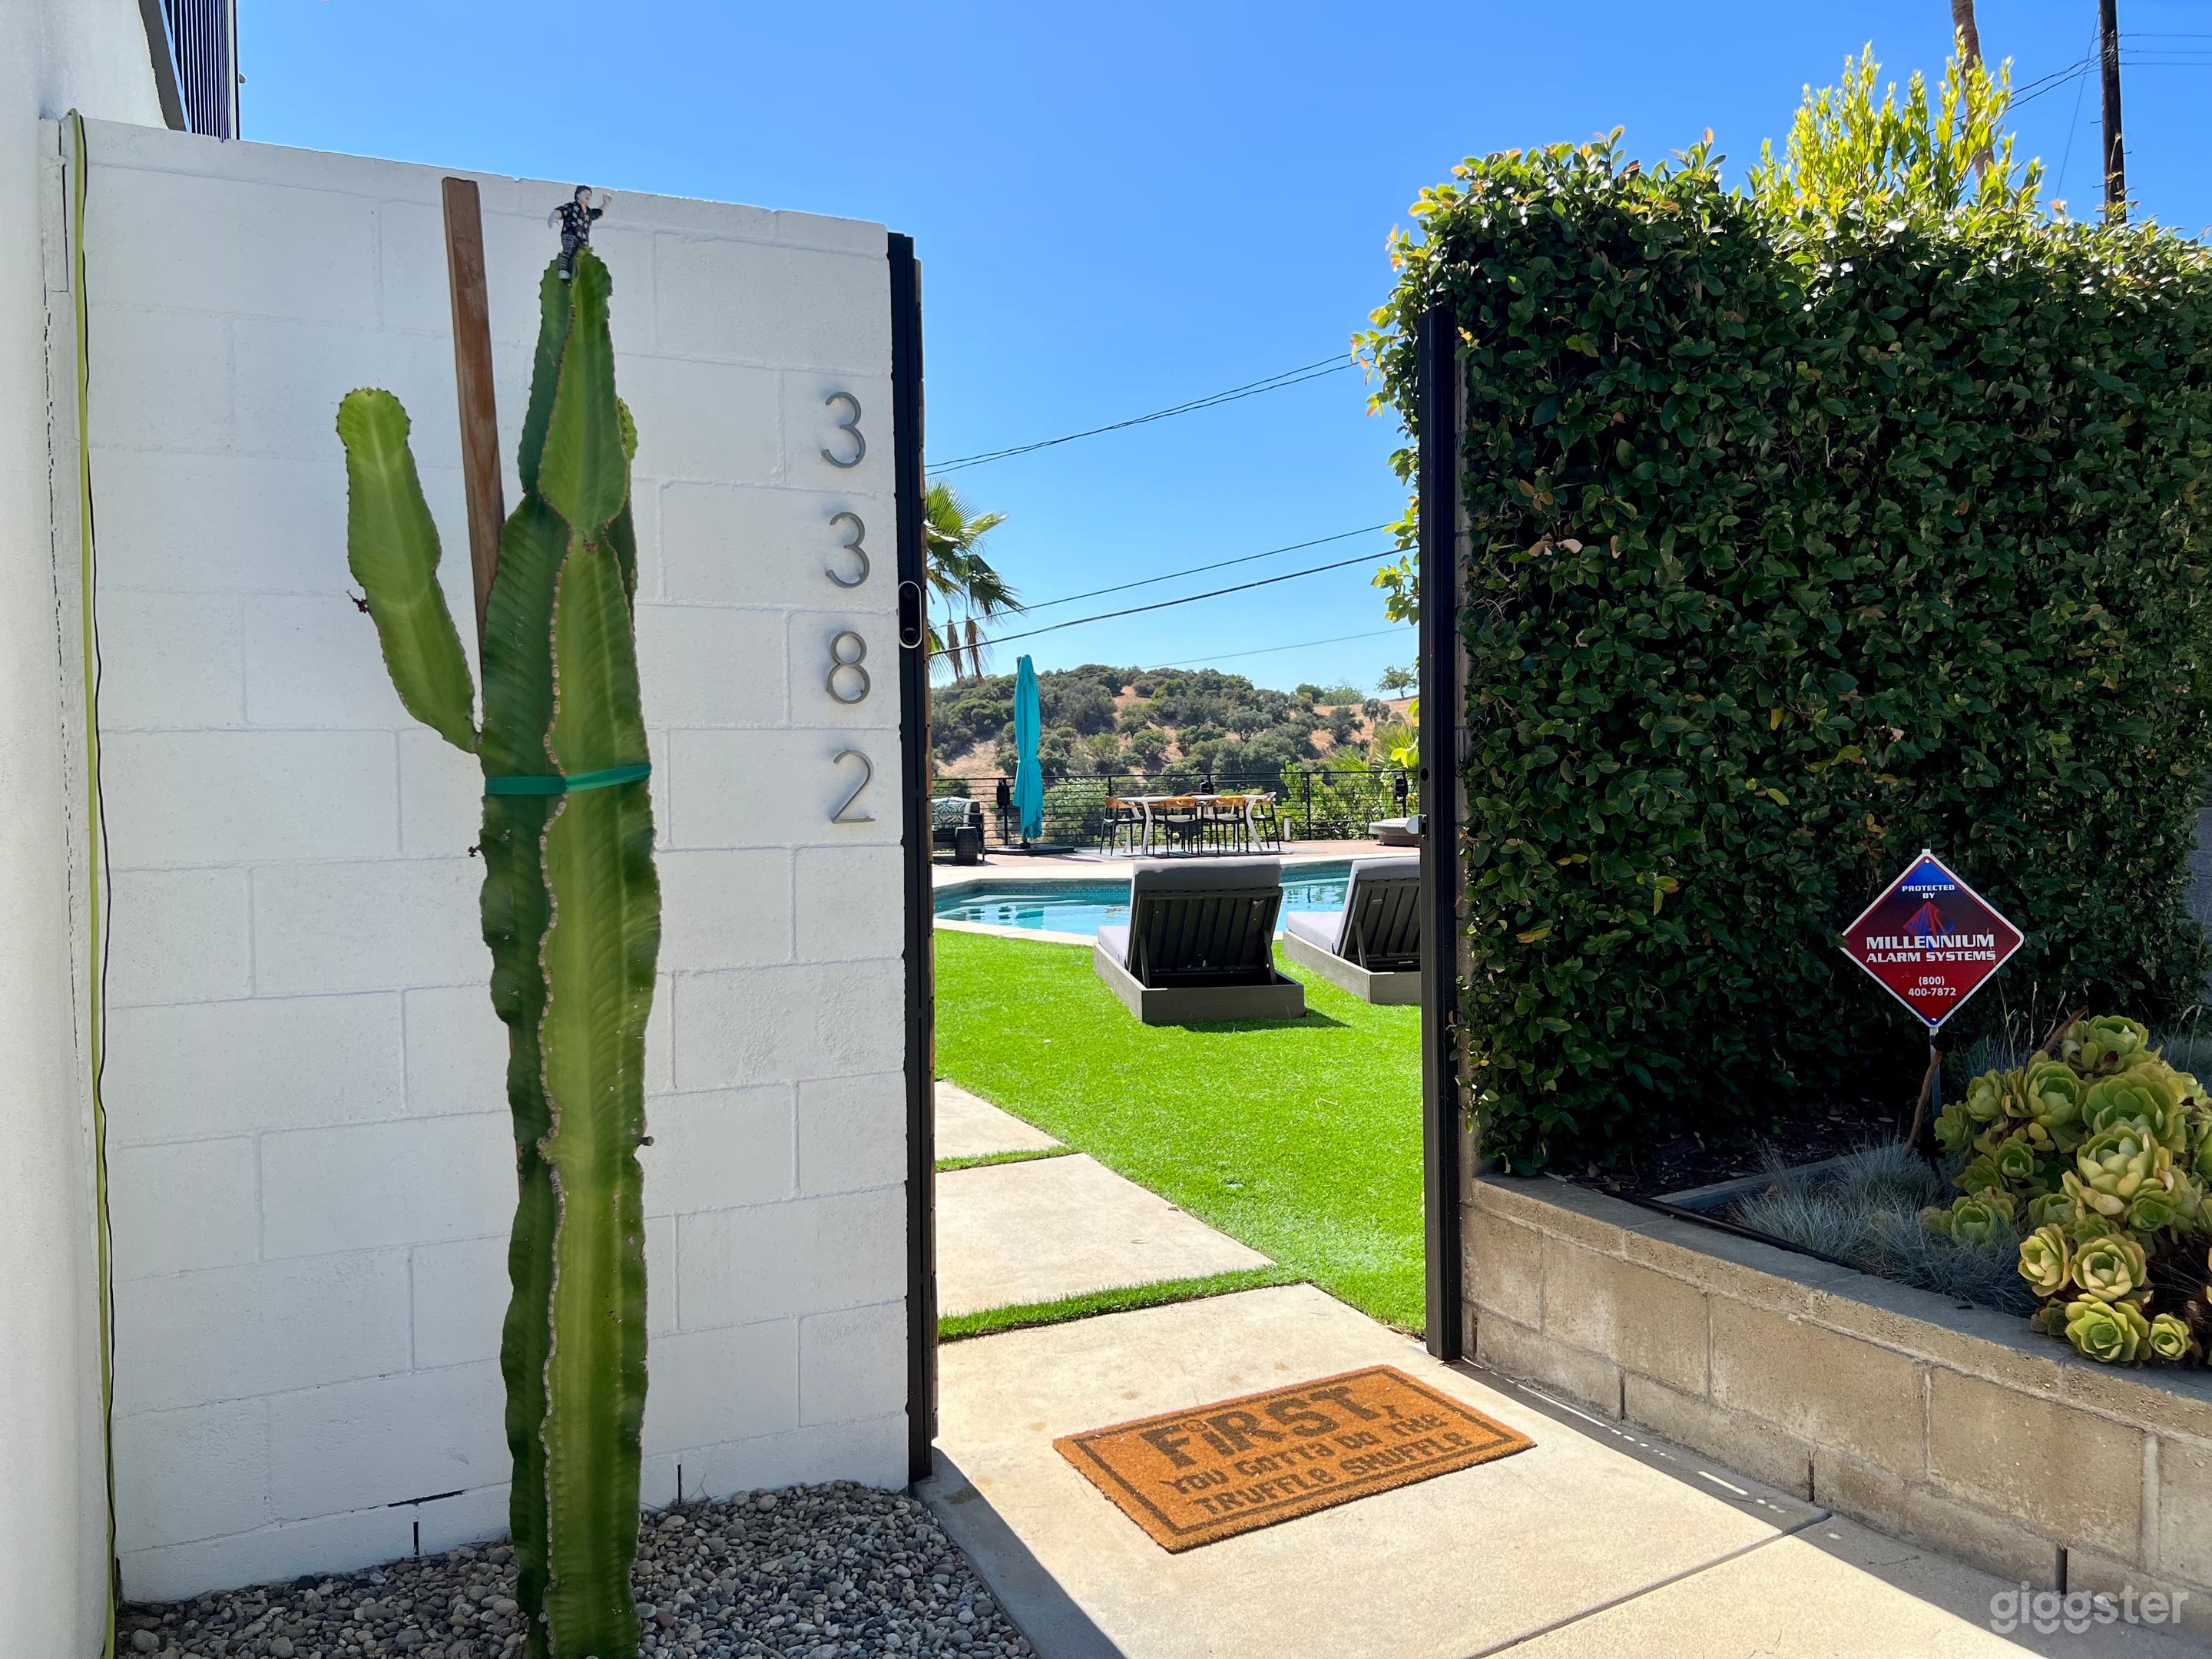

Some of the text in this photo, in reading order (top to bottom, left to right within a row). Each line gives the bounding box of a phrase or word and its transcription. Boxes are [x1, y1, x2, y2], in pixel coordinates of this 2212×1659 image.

[821, 391, 876, 824] 3382
[1866, 933, 1995, 949] MILLENNIUM
[1866, 950, 1996, 962] ALARM SYSTEMS
[1919, 975, 1945, 985] (800)
[1908, 987, 1957, 996] 400-7872
[1159, 1469, 1230, 1495] YOU
